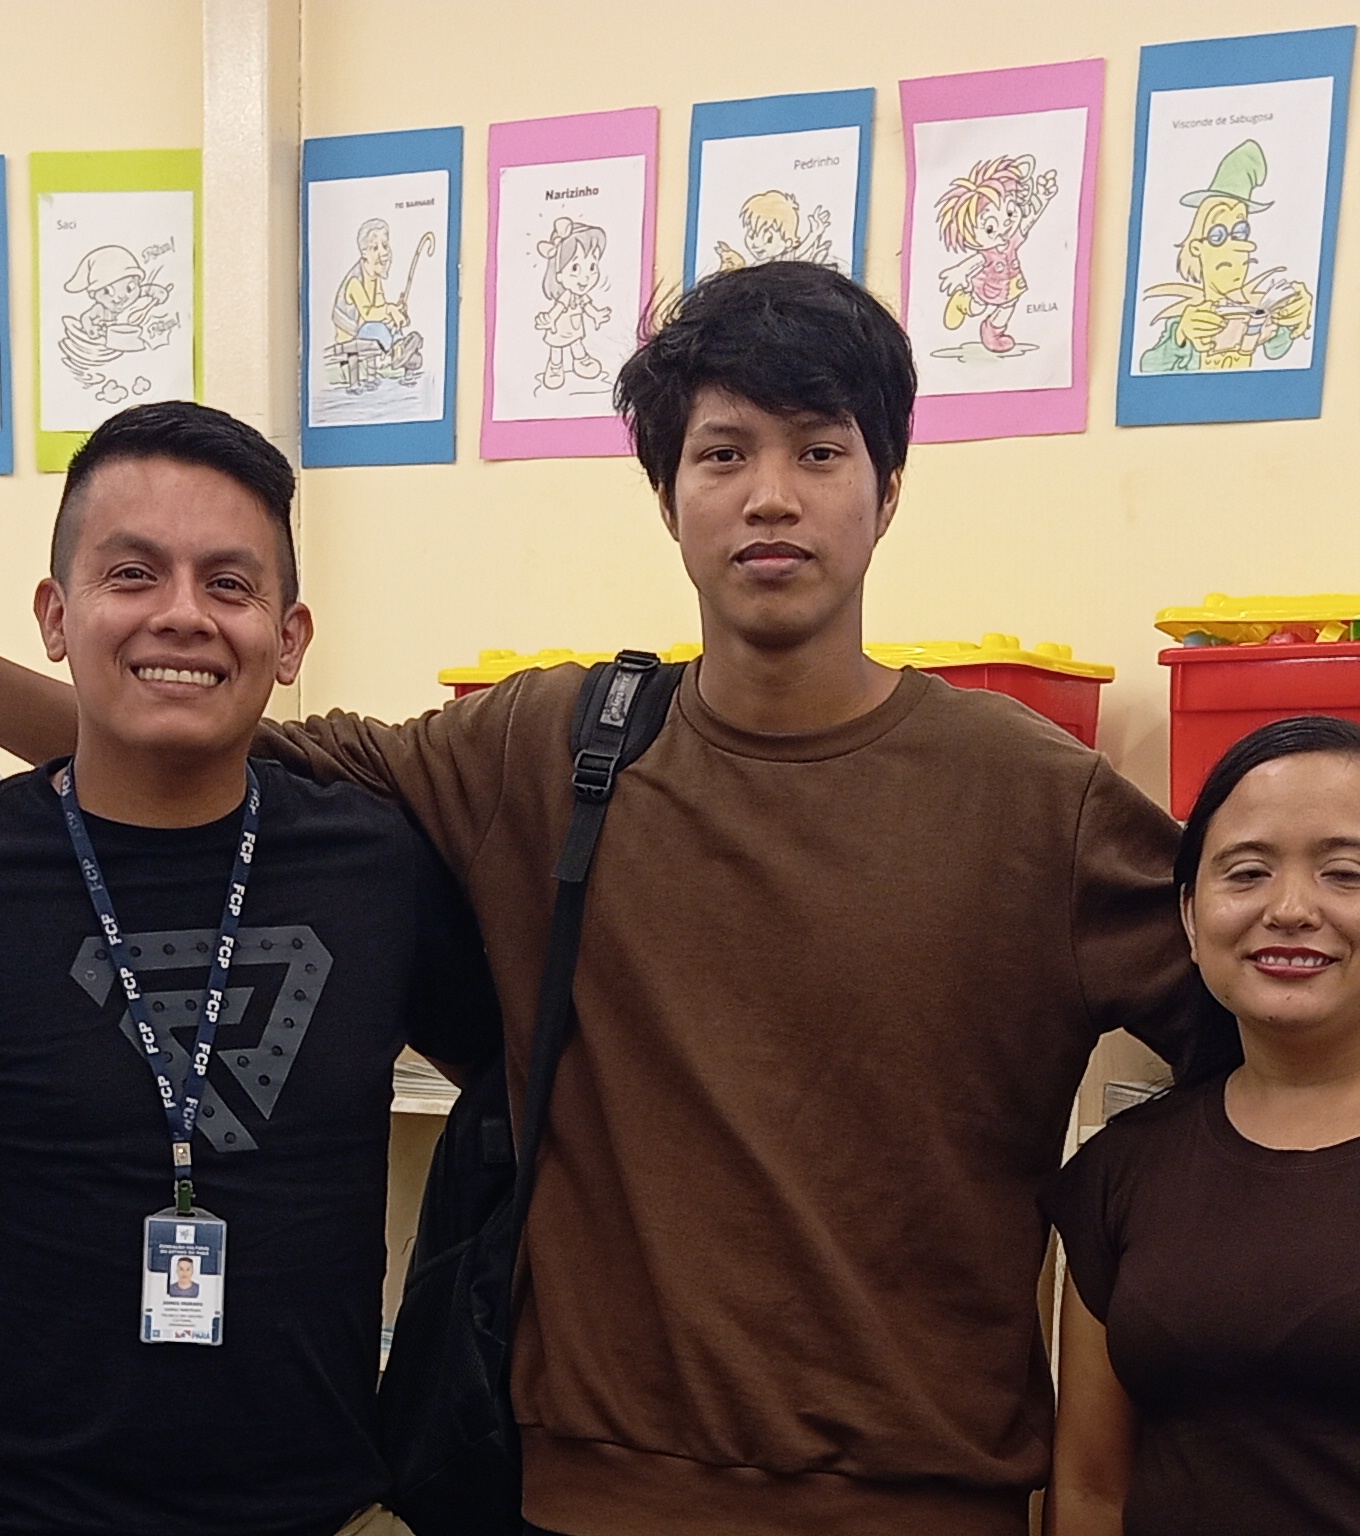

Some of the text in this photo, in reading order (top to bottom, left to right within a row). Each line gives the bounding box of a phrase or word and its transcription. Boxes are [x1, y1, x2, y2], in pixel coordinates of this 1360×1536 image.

[1171, 112, 1274, 130] Visconde de Sabugosa
[793, 155, 840, 171] Pedrinho
[544, 184, 600, 202] Narizinho
[55, 218, 78, 232] Saci
[239, 830, 257, 865] FCP
[228, 881, 246, 917] FCP
[100, 912, 123, 946] FCP
[216, 934, 235, 970] FCP
[119, 966, 141, 1000] FCP
[205, 988, 223, 1024] FCP
[137, 1021, 160, 1055] FCP
[193, 1041, 212, 1077] FCP
[156, 1074, 177, 1109] FCP
